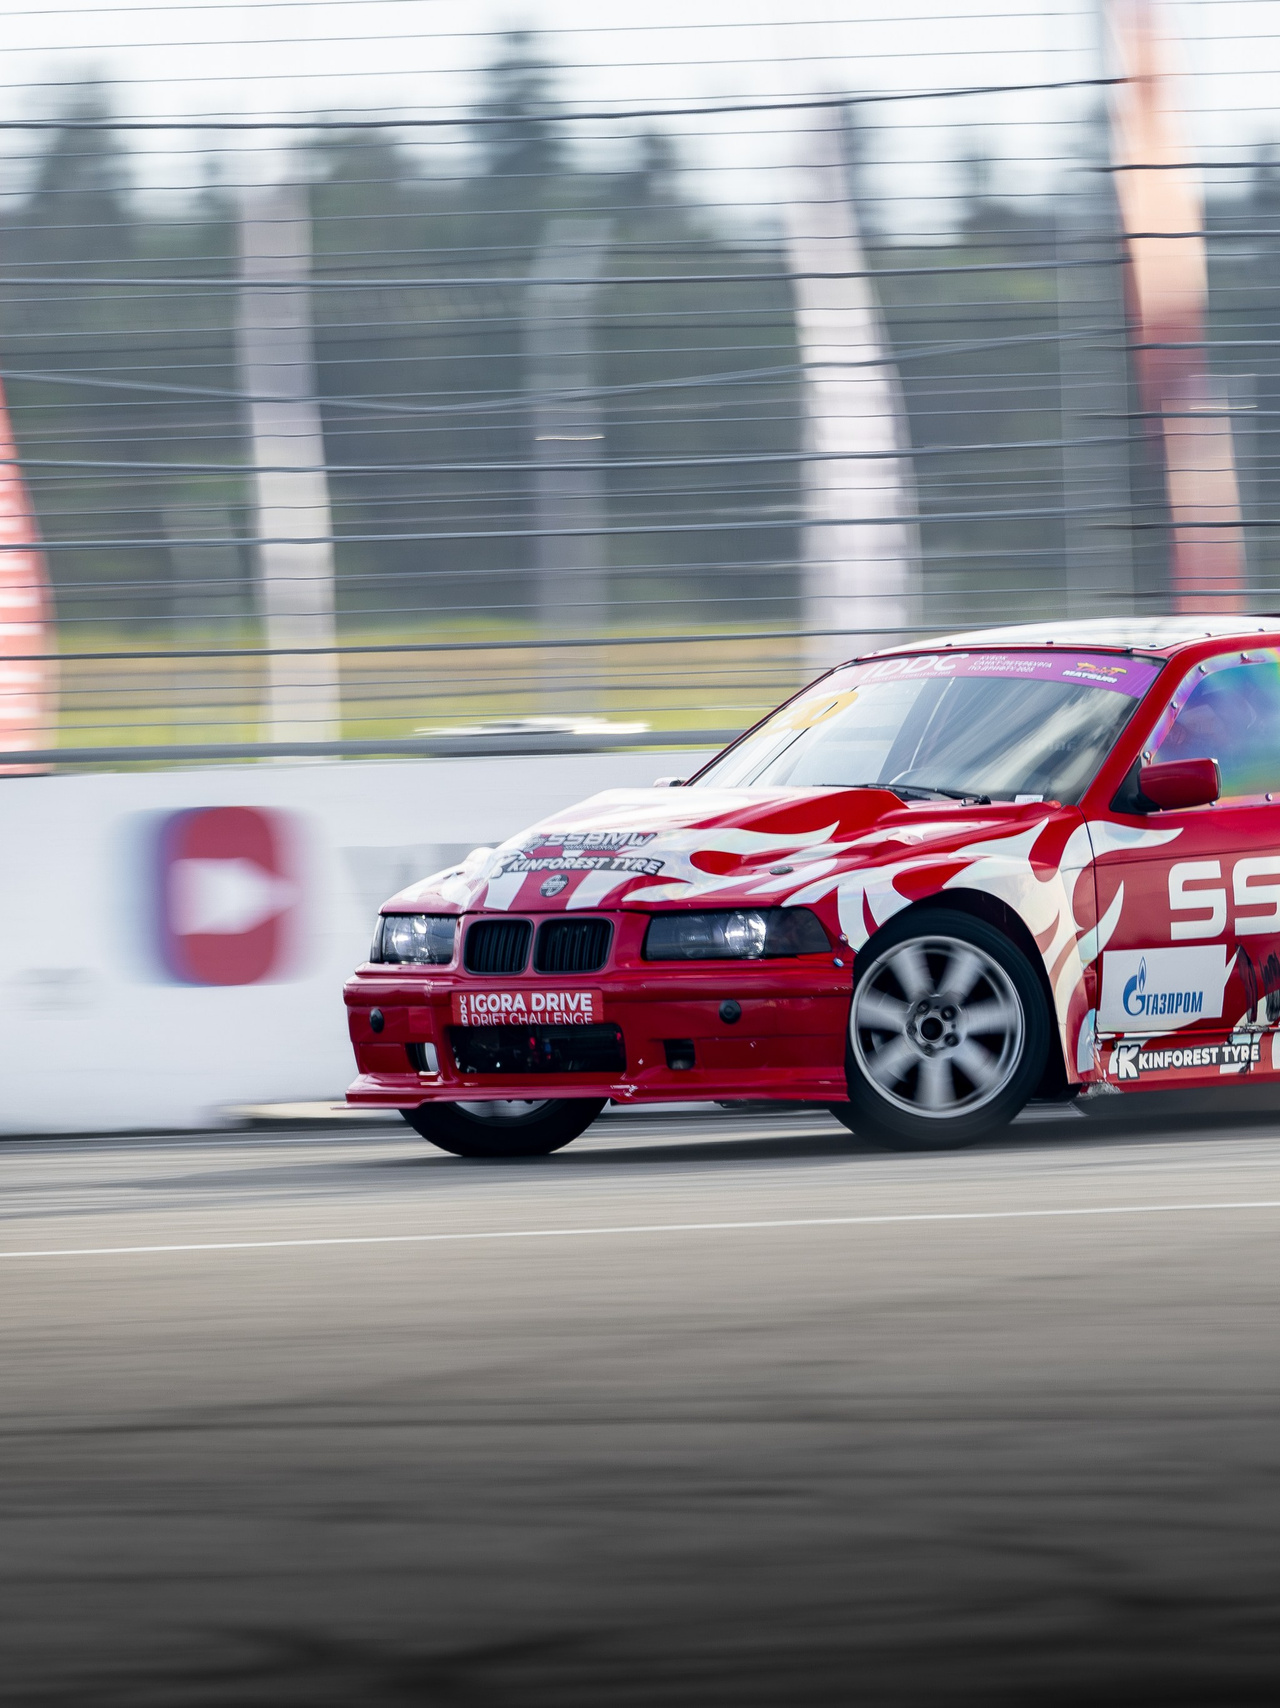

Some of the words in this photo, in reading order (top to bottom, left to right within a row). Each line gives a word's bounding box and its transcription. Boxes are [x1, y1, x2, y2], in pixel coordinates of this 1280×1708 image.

[860, 653, 969, 681] IDDC
[544, 832, 658, 847] SSBMW
[507, 858, 605, 872] KINFOREST
[609, 859, 664, 875] TYRE
[470, 993, 527, 1013] IGORA
[531, 992, 593, 1012] DRIVE
[1146, 991, 1204, 1016] ГАЗПРОМ
[471, 1012, 507, 1027] DRIFT
[509, 1012, 593, 1026] CHALLENGE
[1138, 1047, 1219, 1070] KINFOREST
[1222, 1044, 1260, 1063] TYRE
